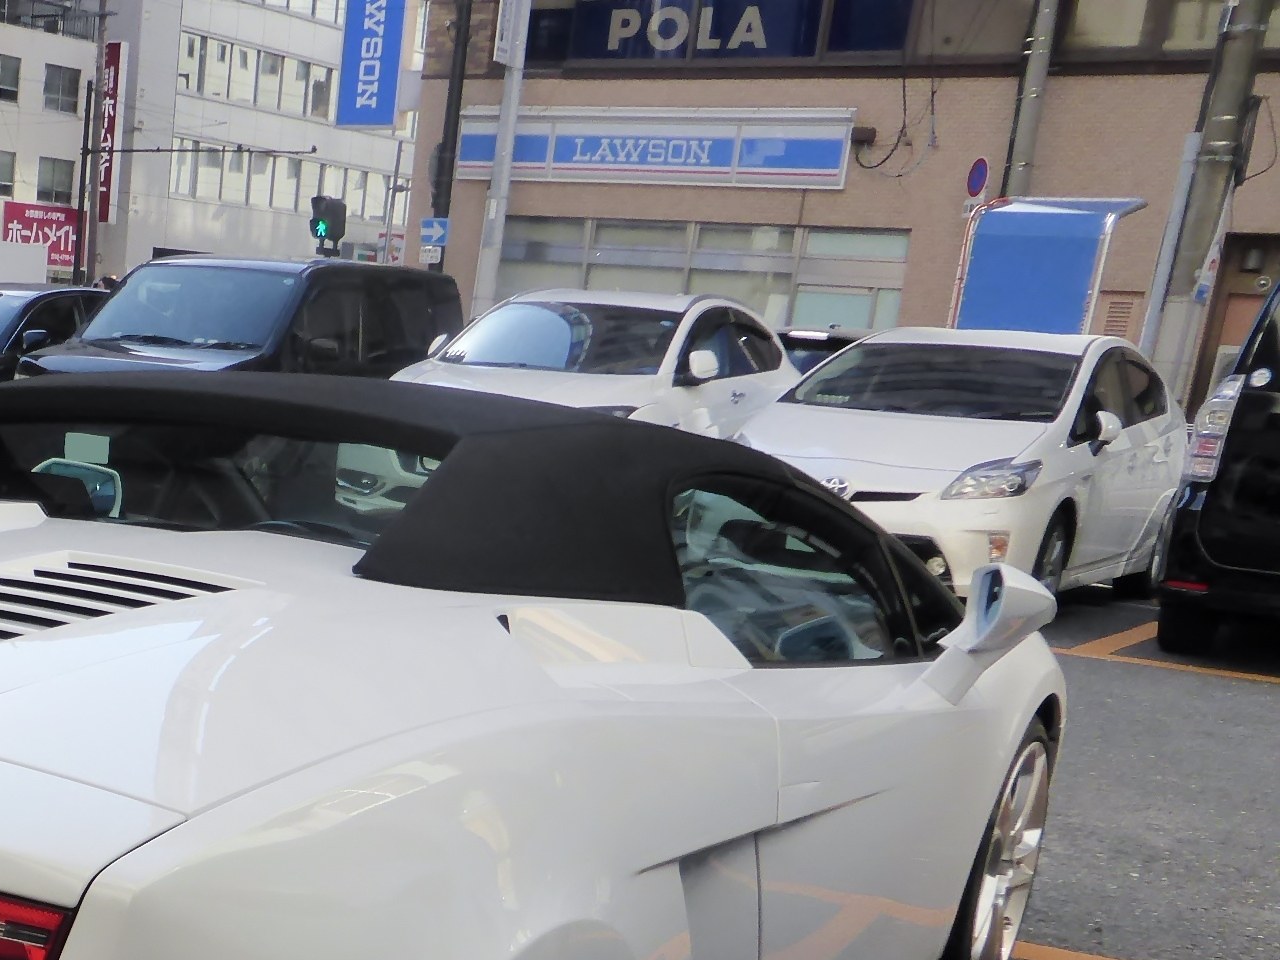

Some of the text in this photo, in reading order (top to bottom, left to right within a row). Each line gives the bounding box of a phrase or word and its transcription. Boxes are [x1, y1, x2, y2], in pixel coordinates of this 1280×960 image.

[607, 6, 767, 50] POLA
[355, 0, 387, 108] WSON
[573, 138, 713, 164] LAWSON
[7, 219, 77, 252] ホームメイト
